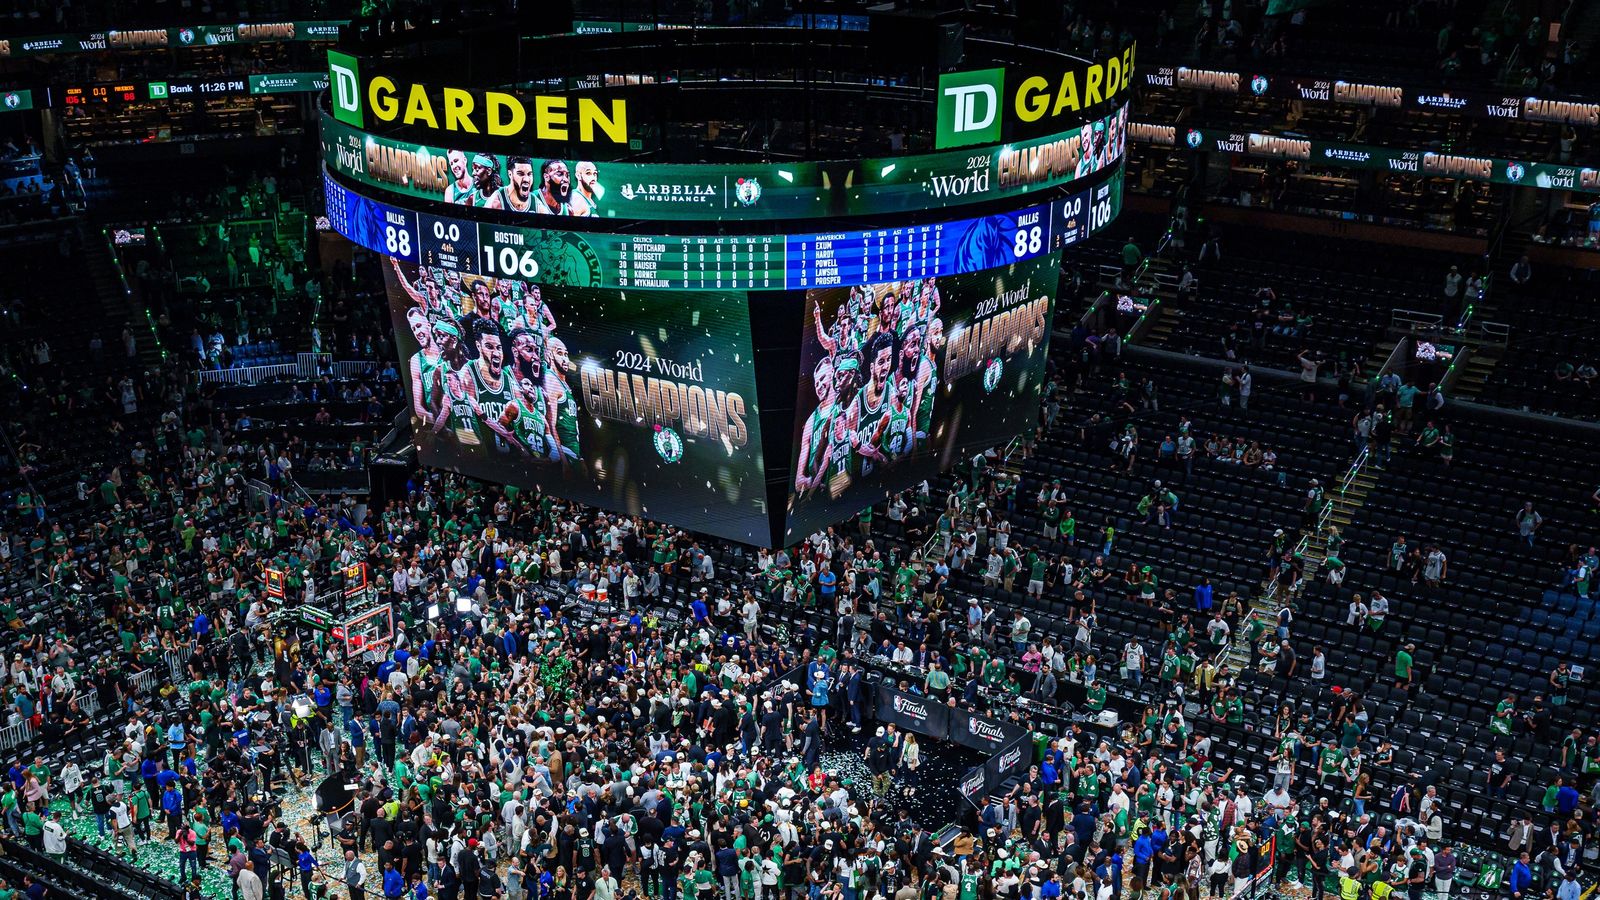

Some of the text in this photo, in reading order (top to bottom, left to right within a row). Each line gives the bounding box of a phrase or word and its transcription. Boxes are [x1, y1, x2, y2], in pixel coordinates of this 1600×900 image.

[109, 29, 168, 46] CHAMPIONS
[210, 32, 234, 42] World
[238, 23, 295, 39] CHAMPIONS
[80, 40, 106, 50] World
[200, 81, 244, 92] 11:26 PM
[1147, 75, 1173, 86] World
[1177, 67, 1240, 91] CHAMPIONS
[1314, 81, 1330, 89] 2024
[171, 84, 192, 93] Bank
[331, 64, 359, 112] TD
[1300, 88, 1329, 100] World
[1334, 81, 1402, 105] CHAMPIONS
[369, 76, 628, 144] GARDEN
[944, 83, 998, 133] TD
[1501, 98, 1519, 106] 2024
[1487, 105, 1518, 118] World
[1524, 98, 1600, 125] CHAMPIONS
[1127, 122, 1176, 144] AMPIONS
[349, 135, 361, 149] 2024
[1217, 140, 1244, 152] World
[336, 143, 363, 173] World
[967, 154, 991, 170] 2024
[997, 136, 1081, 188] CHAMPIONS
[1402, 152, 1419, 160] 2024
[366, 141, 448, 192] CHAMPIONS
[1388, 158, 1417, 172] World
[1423, 152, 1492, 178] CHAMPIONS
[1558, 168, 1575, 176] 2024
[635, 184, 716, 195] ARBELLA
[931, 168, 989, 198] World
[1064, 198, 1081, 218] 0.0
[1092, 197, 1111, 230] 106
[386, 211, 405, 226] DALLAS
[1018, 212, 1039, 227] DALLAS
[434, 221, 460, 242] 0.0
[494, 231, 524, 245] BOSTON
[386, 226, 411, 256] 88
[442, 243, 454, 253] 4th
[634, 244, 665, 252] PRITCHARD
[816, 241, 832, 250] EXUM
[1014, 226, 1041, 257] 88
[484, 245, 539, 278] 106
[634, 253, 662, 261] BRISSETT
[816, 250, 834, 259] HARDY
[578, 241, 600, 288] CELTIC
[816, 259, 838, 268] POWELL
[816, 268, 838, 277] LAWSON
[816, 276, 841, 285] PROSPER
[974, 284, 1030, 319] 2024 World
[944, 295, 1048, 384] CHAMPIONS
[616, 350, 704, 382] 2024 World
[581, 365, 748, 446] CHAMPIONS
[462, 417, 473, 432] 11
[527, 434, 544, 452] 42
[900, 698, 928, 717] Finals
[975, 721, 1005, 739] Finals
[1004, 746, 1021, 769] Finals
[966, 772, 984, 796] Finals
[965, 882, 971, 891] 4
